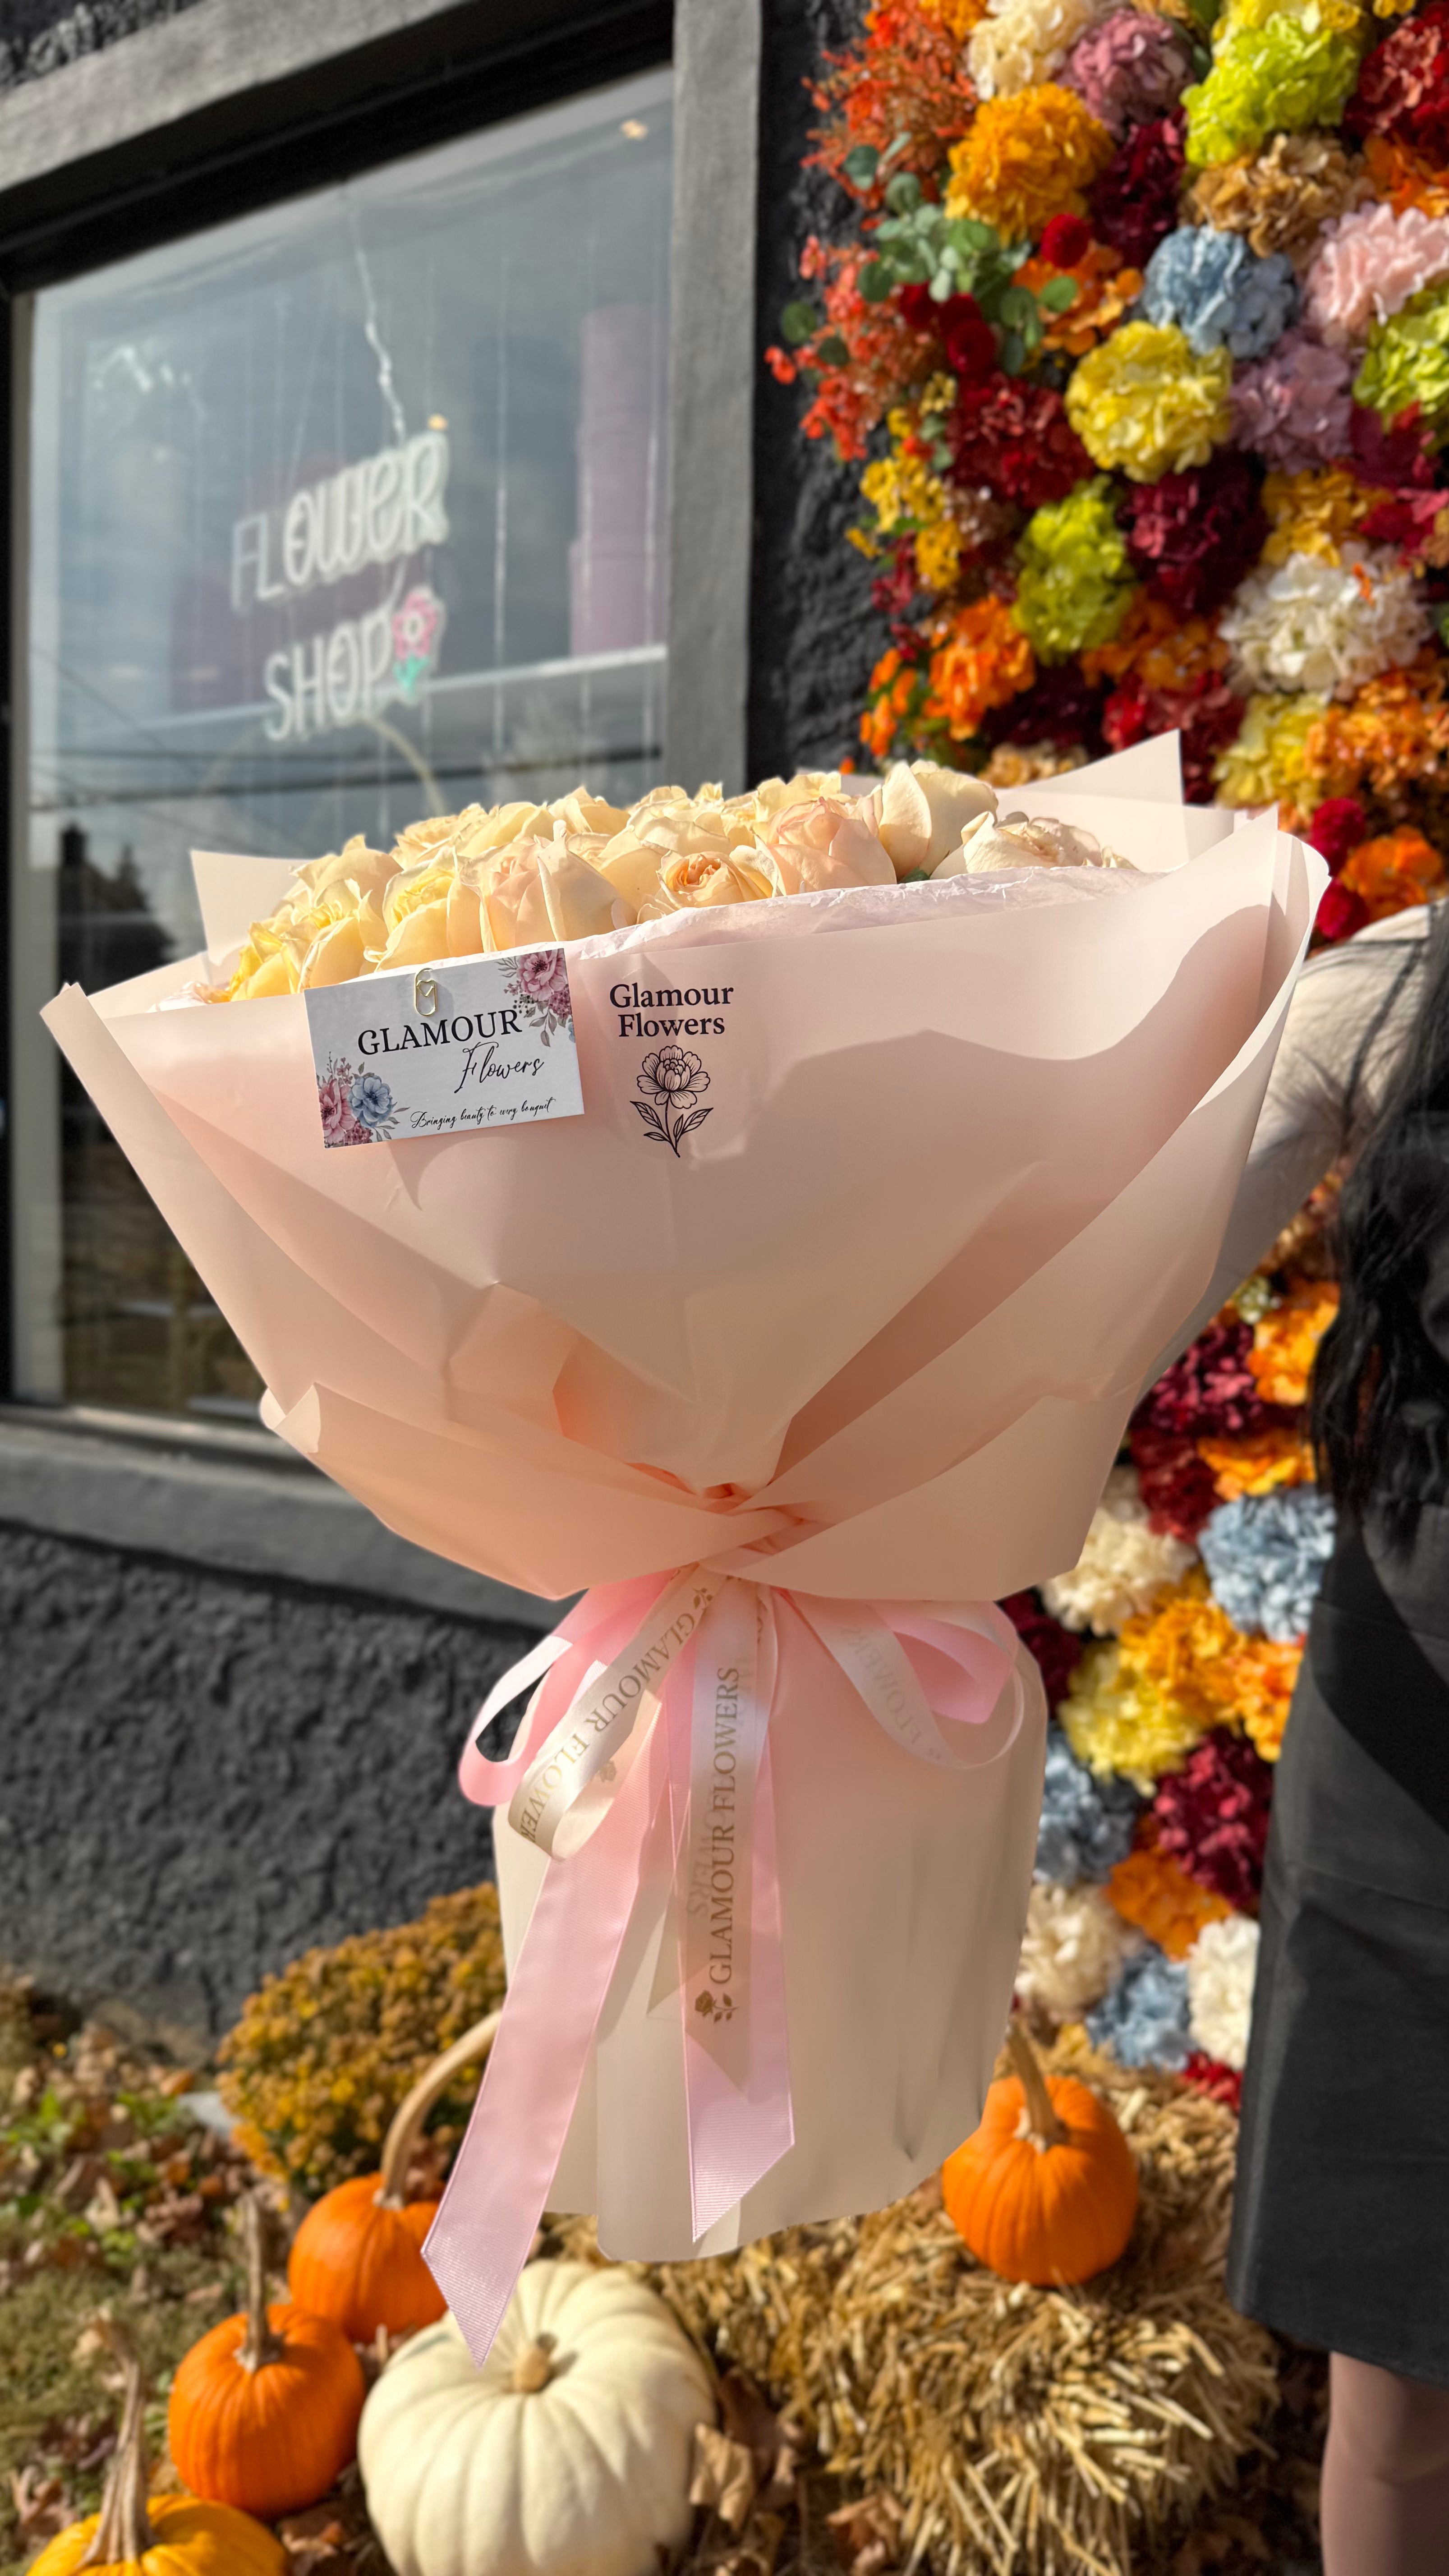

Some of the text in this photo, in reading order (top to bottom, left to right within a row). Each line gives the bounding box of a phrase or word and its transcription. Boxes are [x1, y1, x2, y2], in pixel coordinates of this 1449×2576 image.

[264, 612, 391, 741] SHOP
[610, 982, 734, 1008] Glamour
[358, 1010, 522, 1055] GLAMOUR
[618, 1012, 725, 1037] Flowers
[454, 1041, 544, 1094] Flowers
[410, 1097, 556, 1130] Bringing beauty to every bouquet
[584, 1613, 695, 1733] GLAMOUR
[709, 1668, 739, 1985] GLAMOUR FLOWERS
